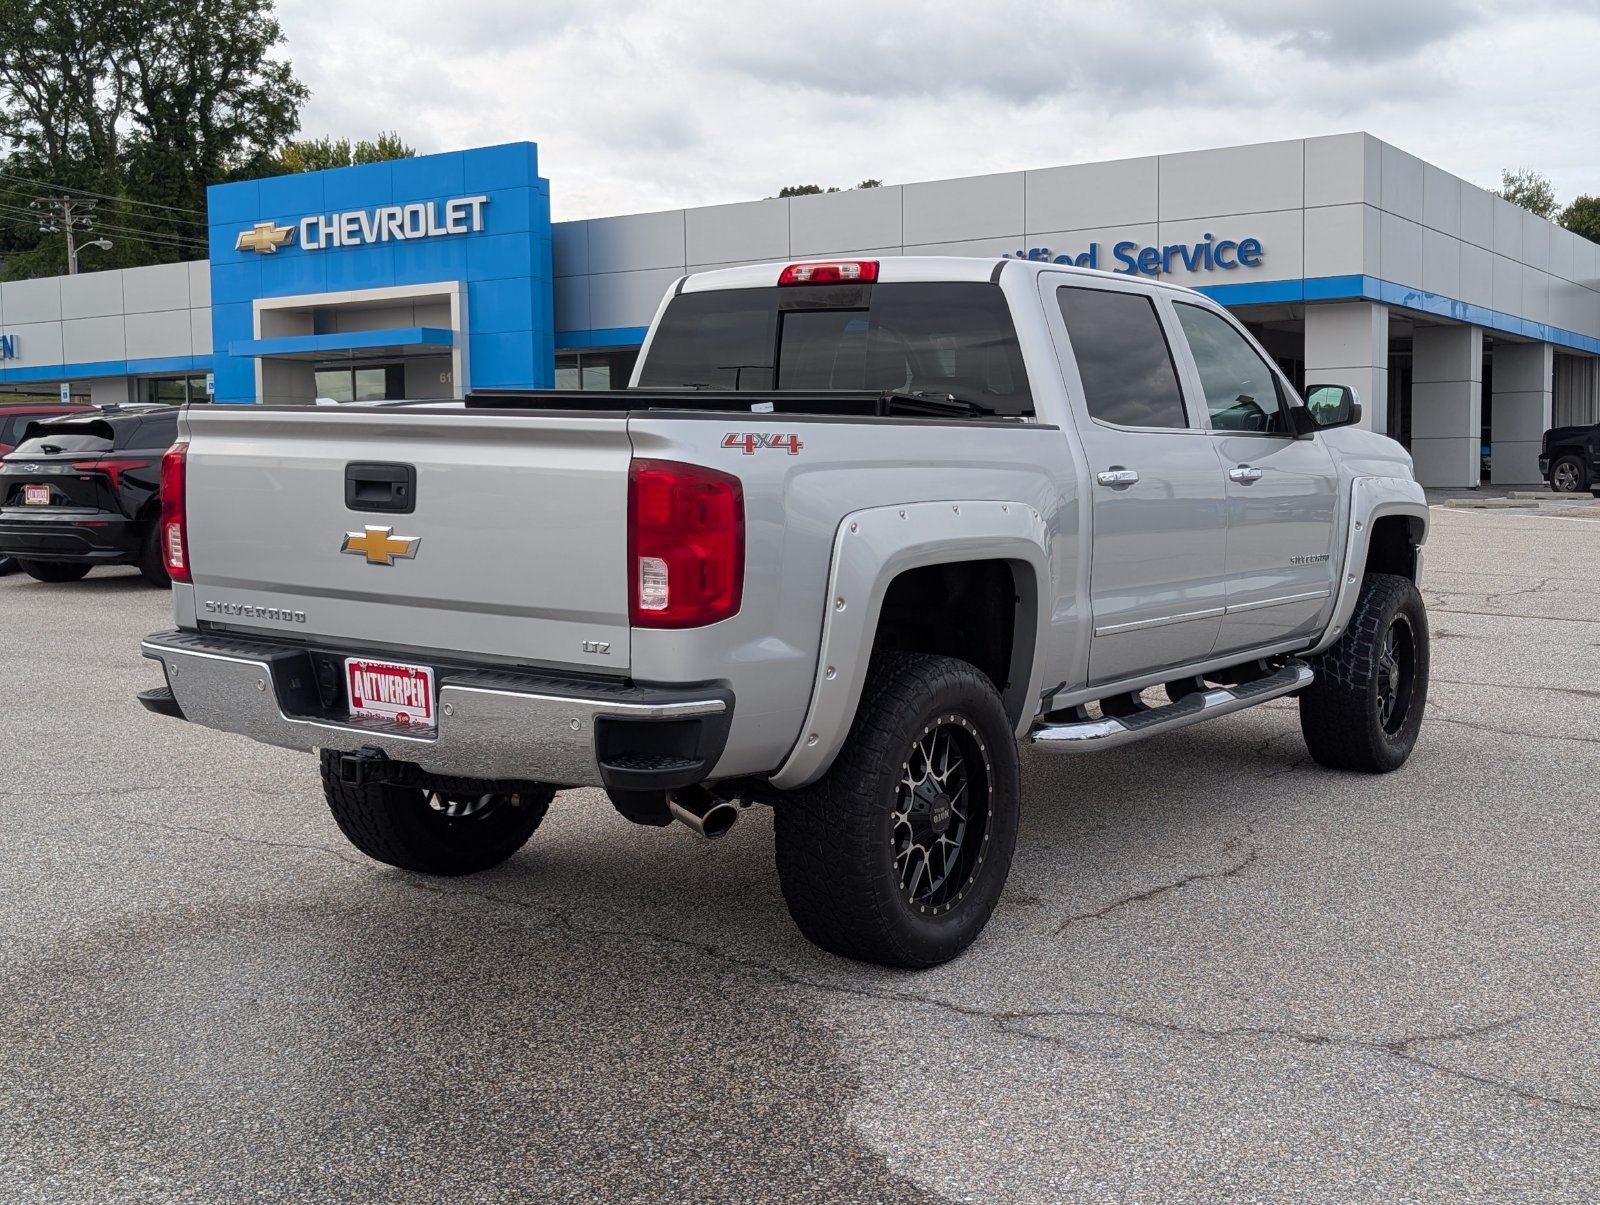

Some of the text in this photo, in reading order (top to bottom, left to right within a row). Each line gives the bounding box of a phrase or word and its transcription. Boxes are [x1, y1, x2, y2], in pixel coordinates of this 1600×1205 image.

[300, 195, 488, 251] CHEVROLET
[1113, 232, 1263, 275] Service
[205, 600, 307, 624] SILVERADO
[582, 640, 611, 655] LTZ
[354, 670, 426, 709] ANTWERPEN
